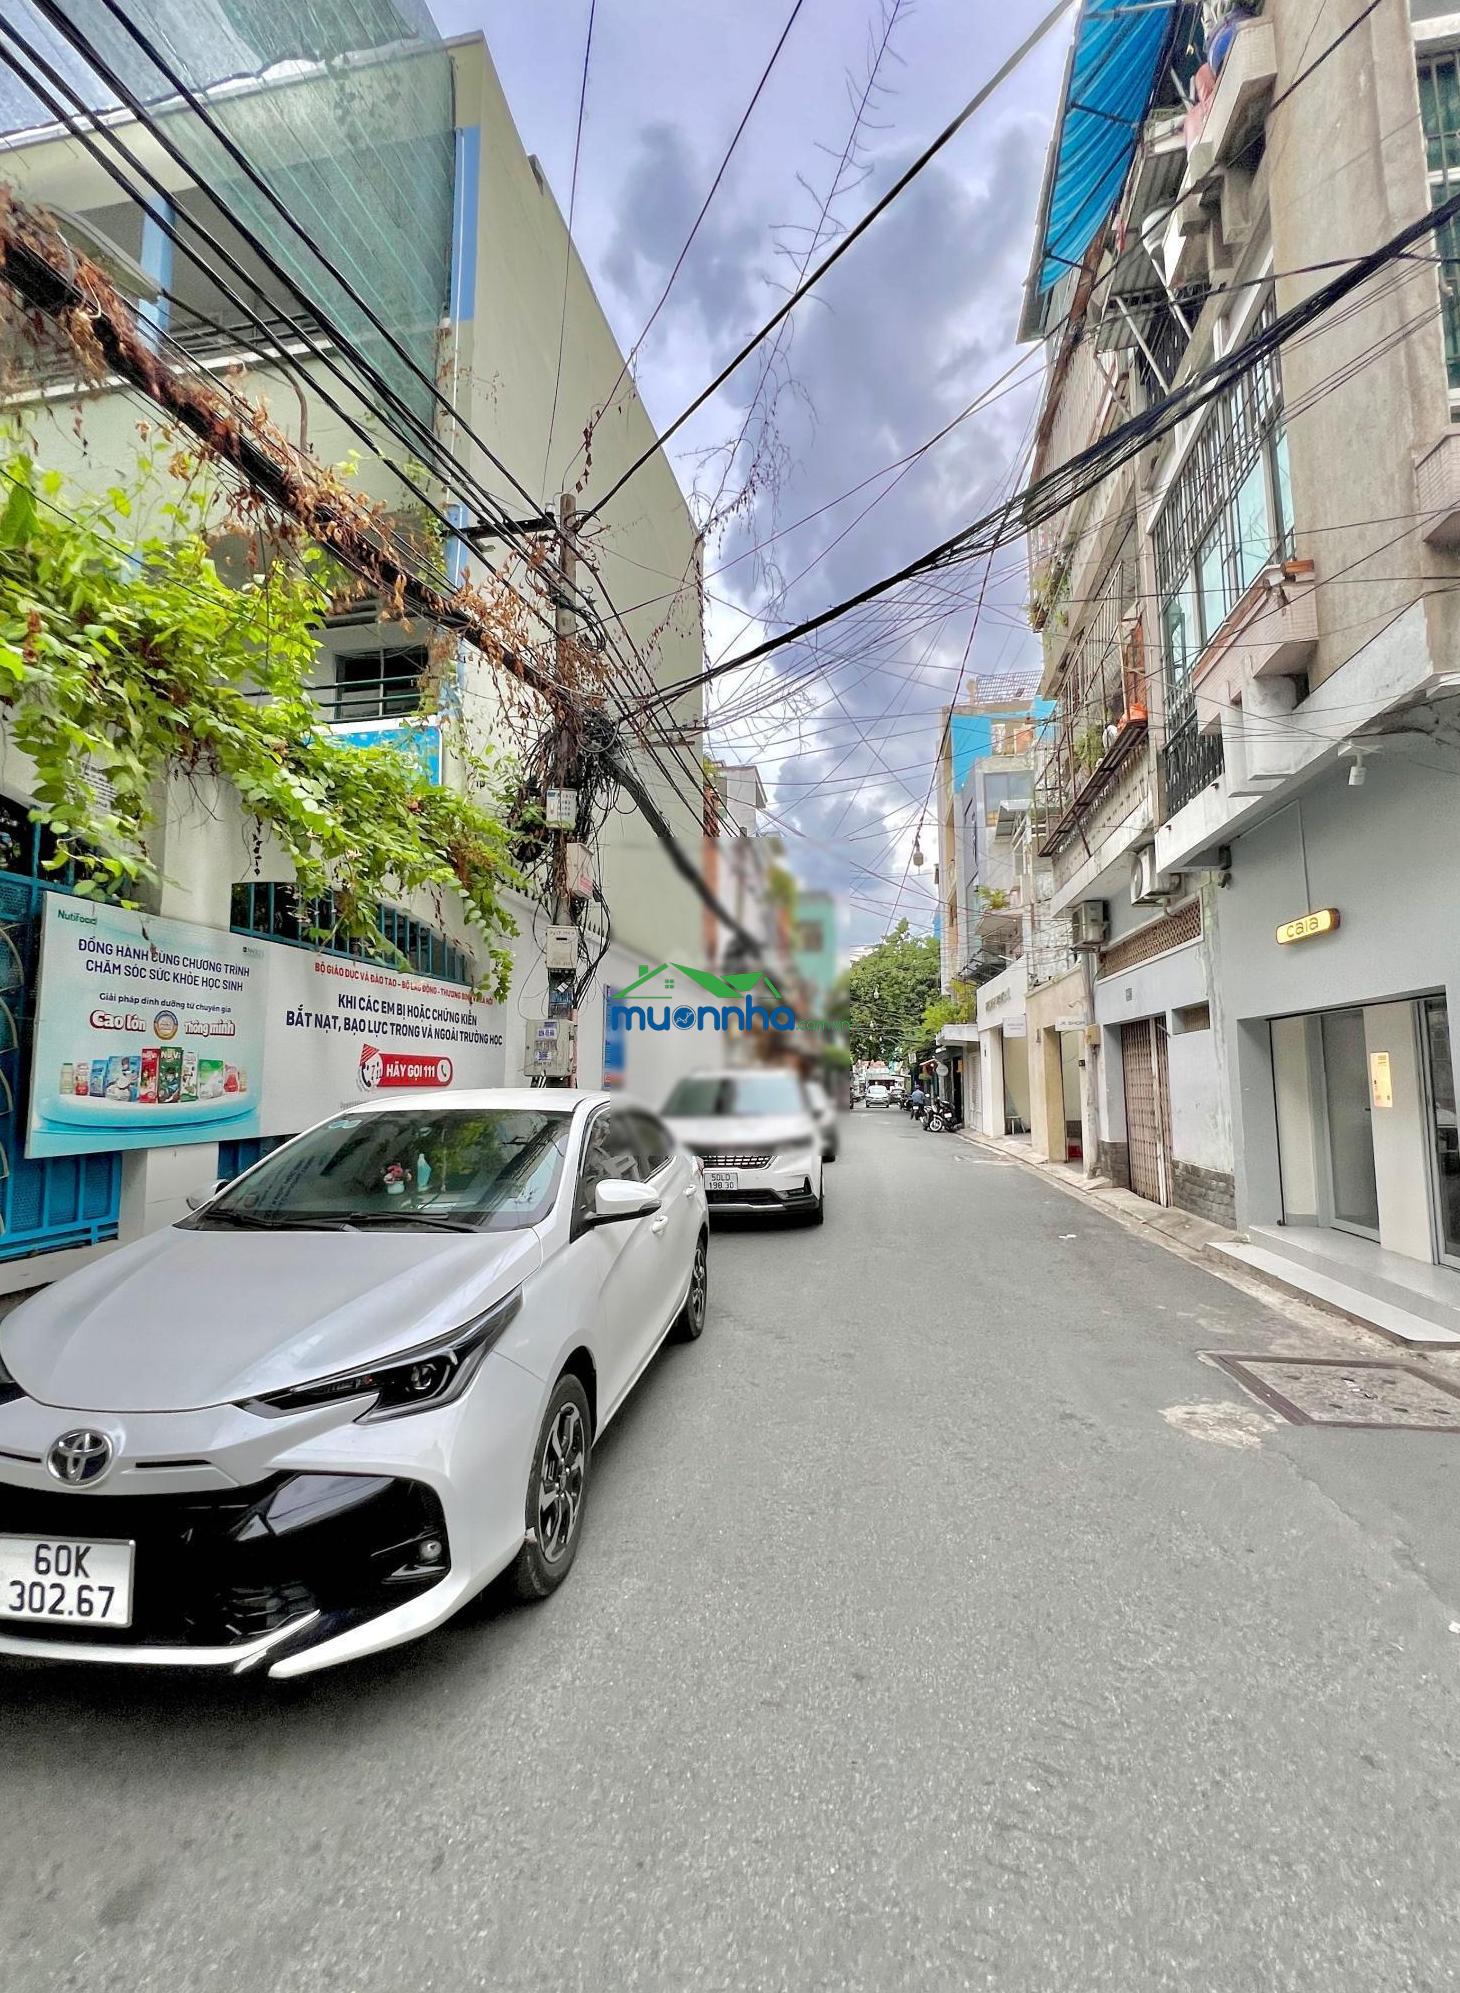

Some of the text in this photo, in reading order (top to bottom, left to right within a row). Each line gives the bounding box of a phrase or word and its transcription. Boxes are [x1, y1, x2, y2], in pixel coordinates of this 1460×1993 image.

[86, 959, 121, 976] CHĂM
[124, 963, 146, 979] SÓC
[149, 967, 171, 982] SỨC
[201, 976, 221, 991] HỌC
[222, 980, 243, 992] SINH
[116, 944, 148, 961] HÀNH
[182, 956, 222, 973] CHƯƠNG
[224, 963, 250, 977] TRÌNH
[326, 964, 344, 977] GIÁO
[360, 970, 369, 982] VÀ
[370, 973, 384, 985] ĐÀO
[90, 1009, 124, 1030] Cao
[99, 992, 117, 1001] Giải
[118, 994, 140, 1005] pháp
[141, 997, 160, 1006] dinh
[221, 1006, 232, 1015] gia
[338, 993, 357, 1010] KHI
[358, 995, 380, 1013] CÁC
[381, 1000, 395, 1016] EM
[396, 1002, 406, 1020] BỊ
[407, 1003, 431, 1022] HOẶC
[432, 1007, 460, 1024] CHỨNG
[286, 1003, 313, 1028] BẮT
[314, 1013, 341, 1034] NẠT,
[343, 1016, 366, 1036] BẠO
[368, 1019, 388, 1038] LỰC
[389, 1021, 420, 1039] TRONG
[421, 1024, 433, 1040] VÀ
[434, 1026, 459, 1042] NGOÀI
[460, 1029, 489, 1045] TRƯỜNG
[386, 1060, 435, 1081] HÃY GỌI 111
[34, 1543, 91, 1579] 60K
[8, 1579, 115, 1619] 302.67
